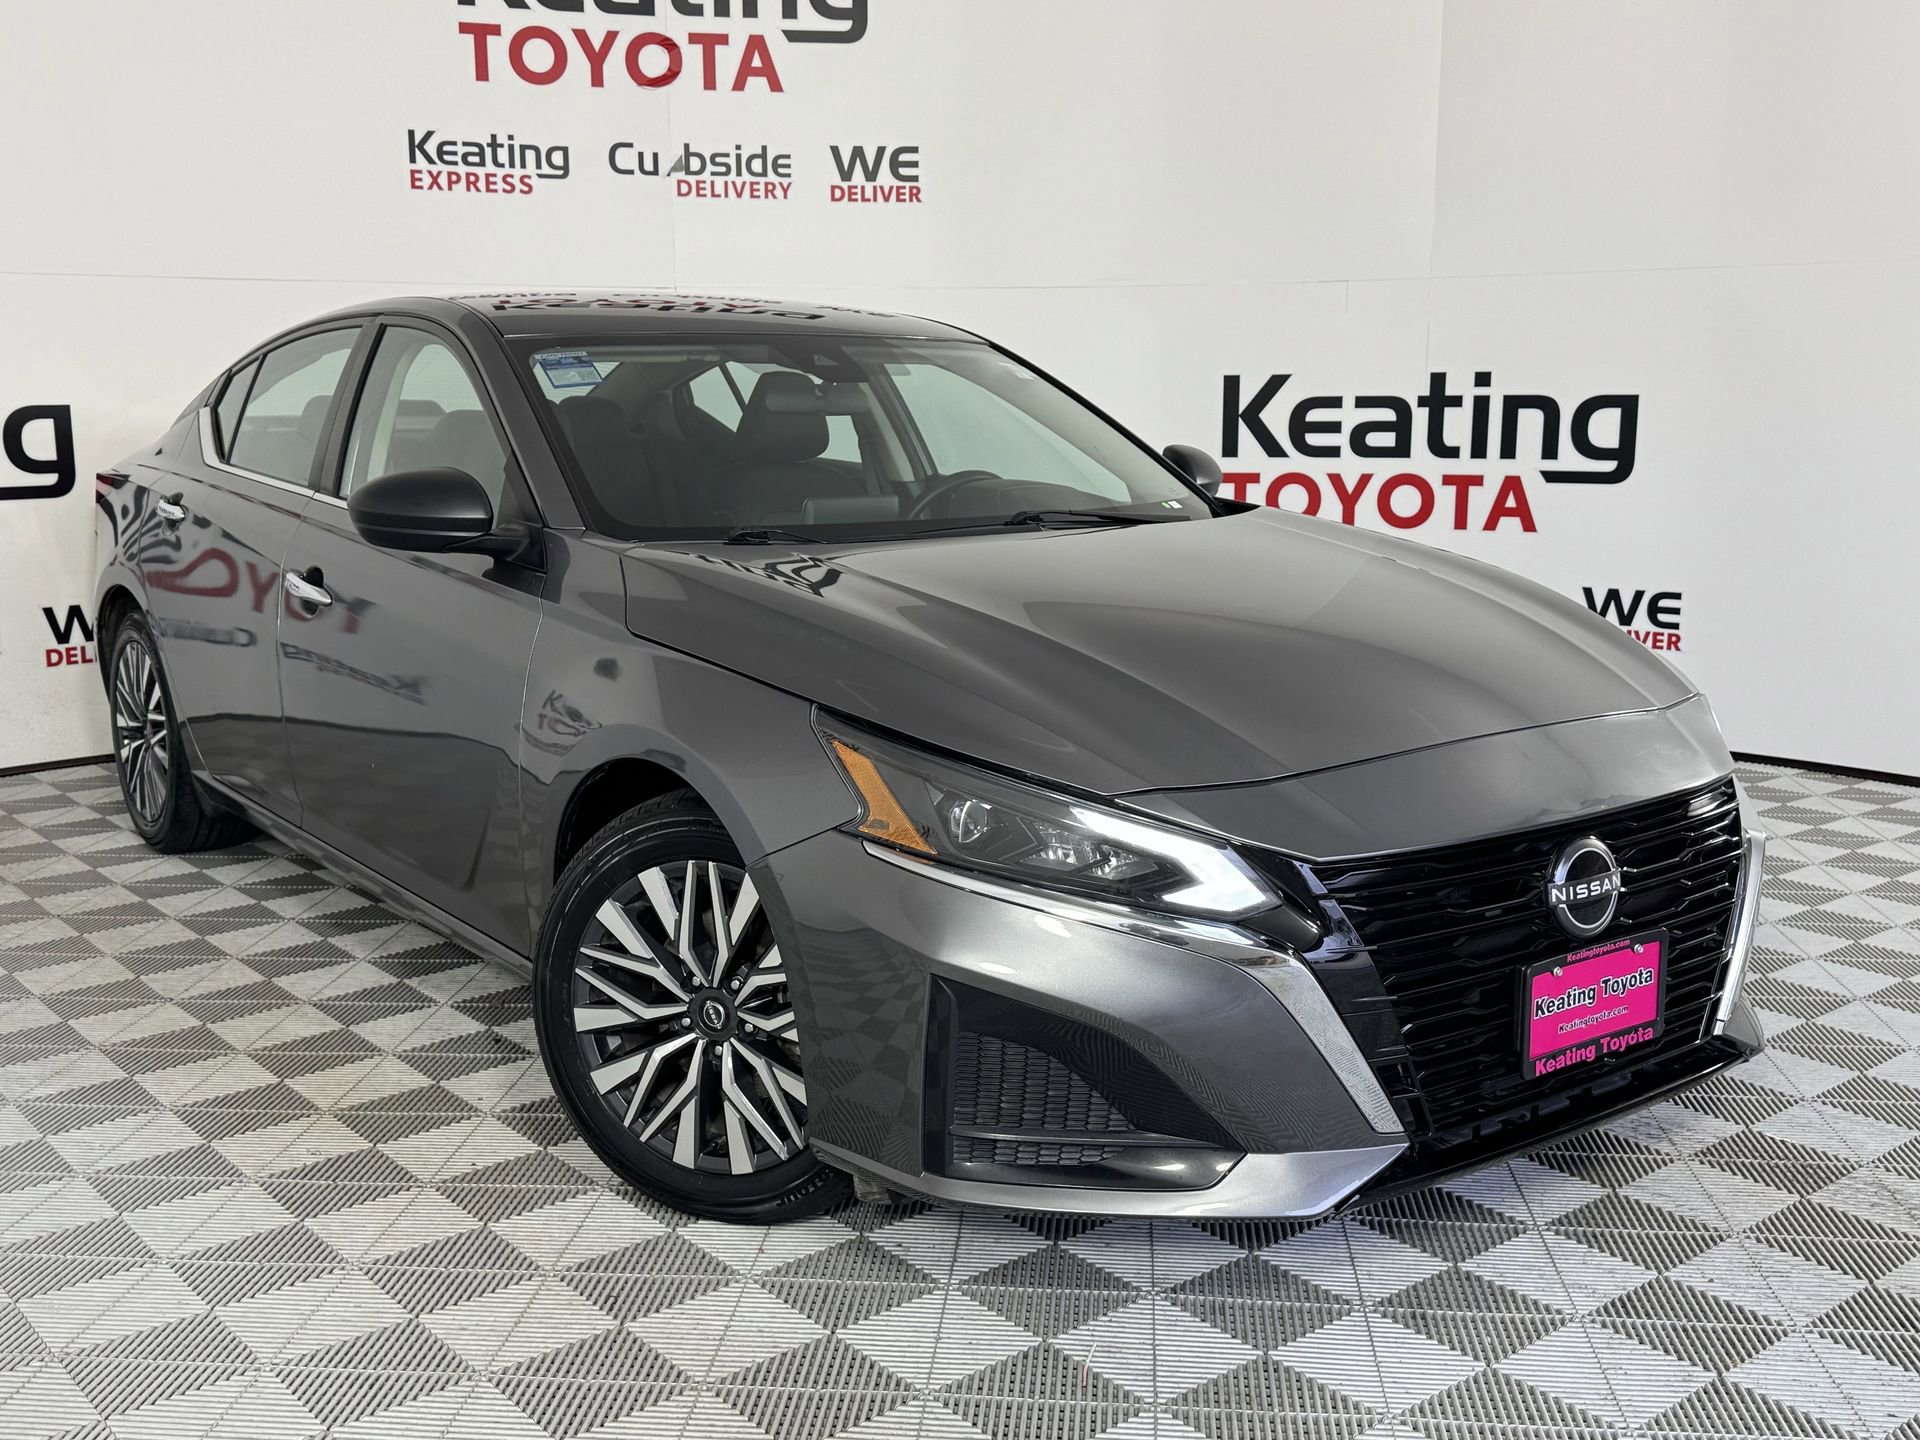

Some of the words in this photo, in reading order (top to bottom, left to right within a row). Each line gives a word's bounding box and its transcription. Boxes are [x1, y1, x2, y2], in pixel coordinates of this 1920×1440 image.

[458, 21, 784, 93] TOYOTA
[408, 129, 569, 179] Keating
[608, 142, 792, 178] Cubside
[829, 145, 919, 183] WE
[409, 169, 533, 194] EXPRESS
[676, 179, 792, 200] DELIVERY
[830, 185, 922, 203] DELIVER
[1222, 372, 1640, 484] Keating
[1222, 472, 1537, 532] TOYOTA
[1582, 587, 1682, 630] WE
[1551, 873, 1621, 902] NISSAN
[1534, 984, 1597, 1020] Keating
[1600, 967, 1654, 998] Toyota
[1535, 1044, 1597, 1077] Keating
[1600, 1027, 1654, 1054] Toyota
